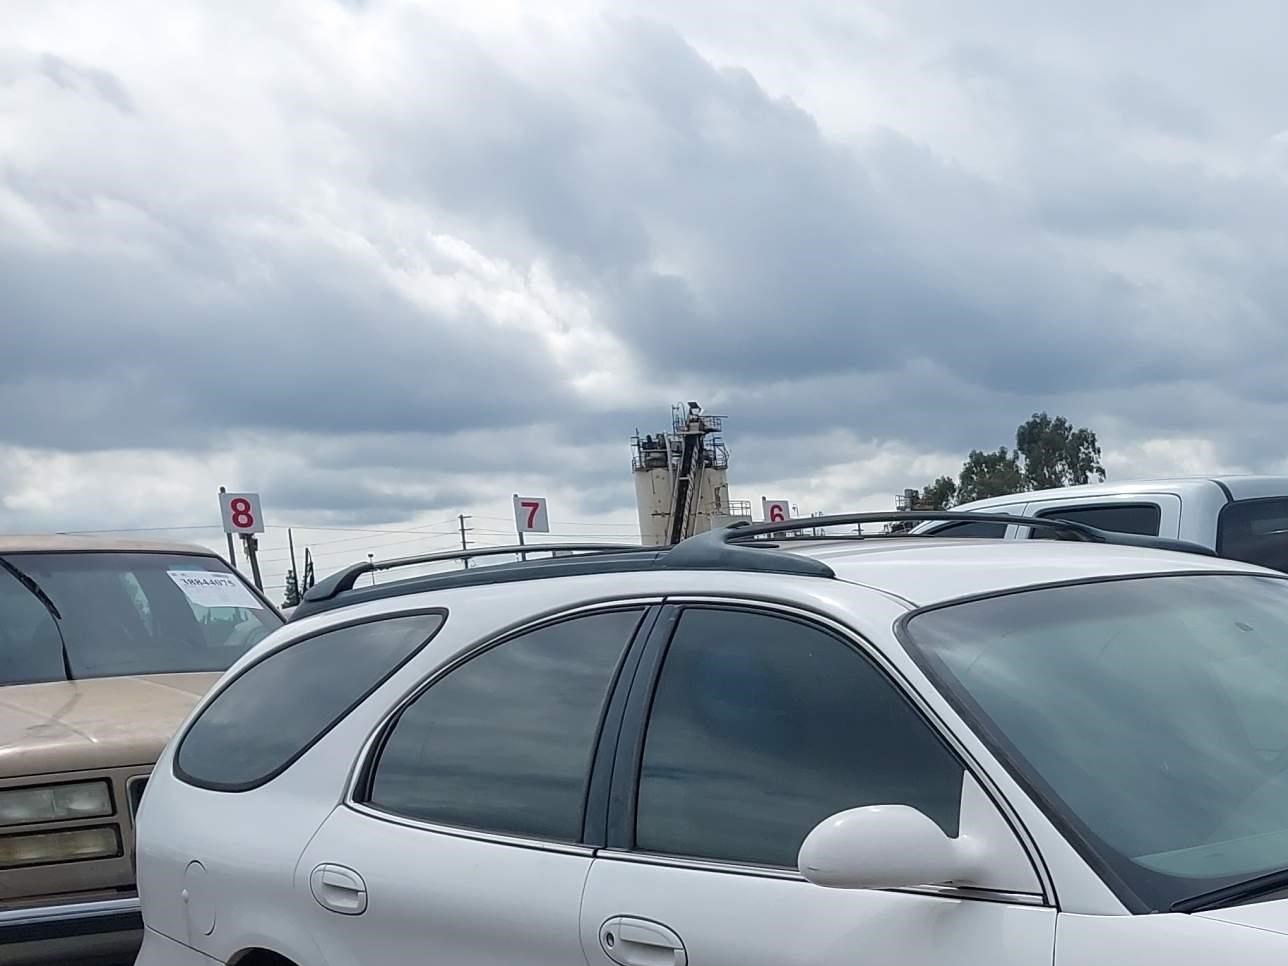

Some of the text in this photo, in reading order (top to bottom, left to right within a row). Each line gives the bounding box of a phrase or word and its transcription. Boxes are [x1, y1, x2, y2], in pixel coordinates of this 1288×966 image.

[230, 497, 254, 528] 8
[520, 501, 540, 529] 7
[769, 504, 785, 522] 6
